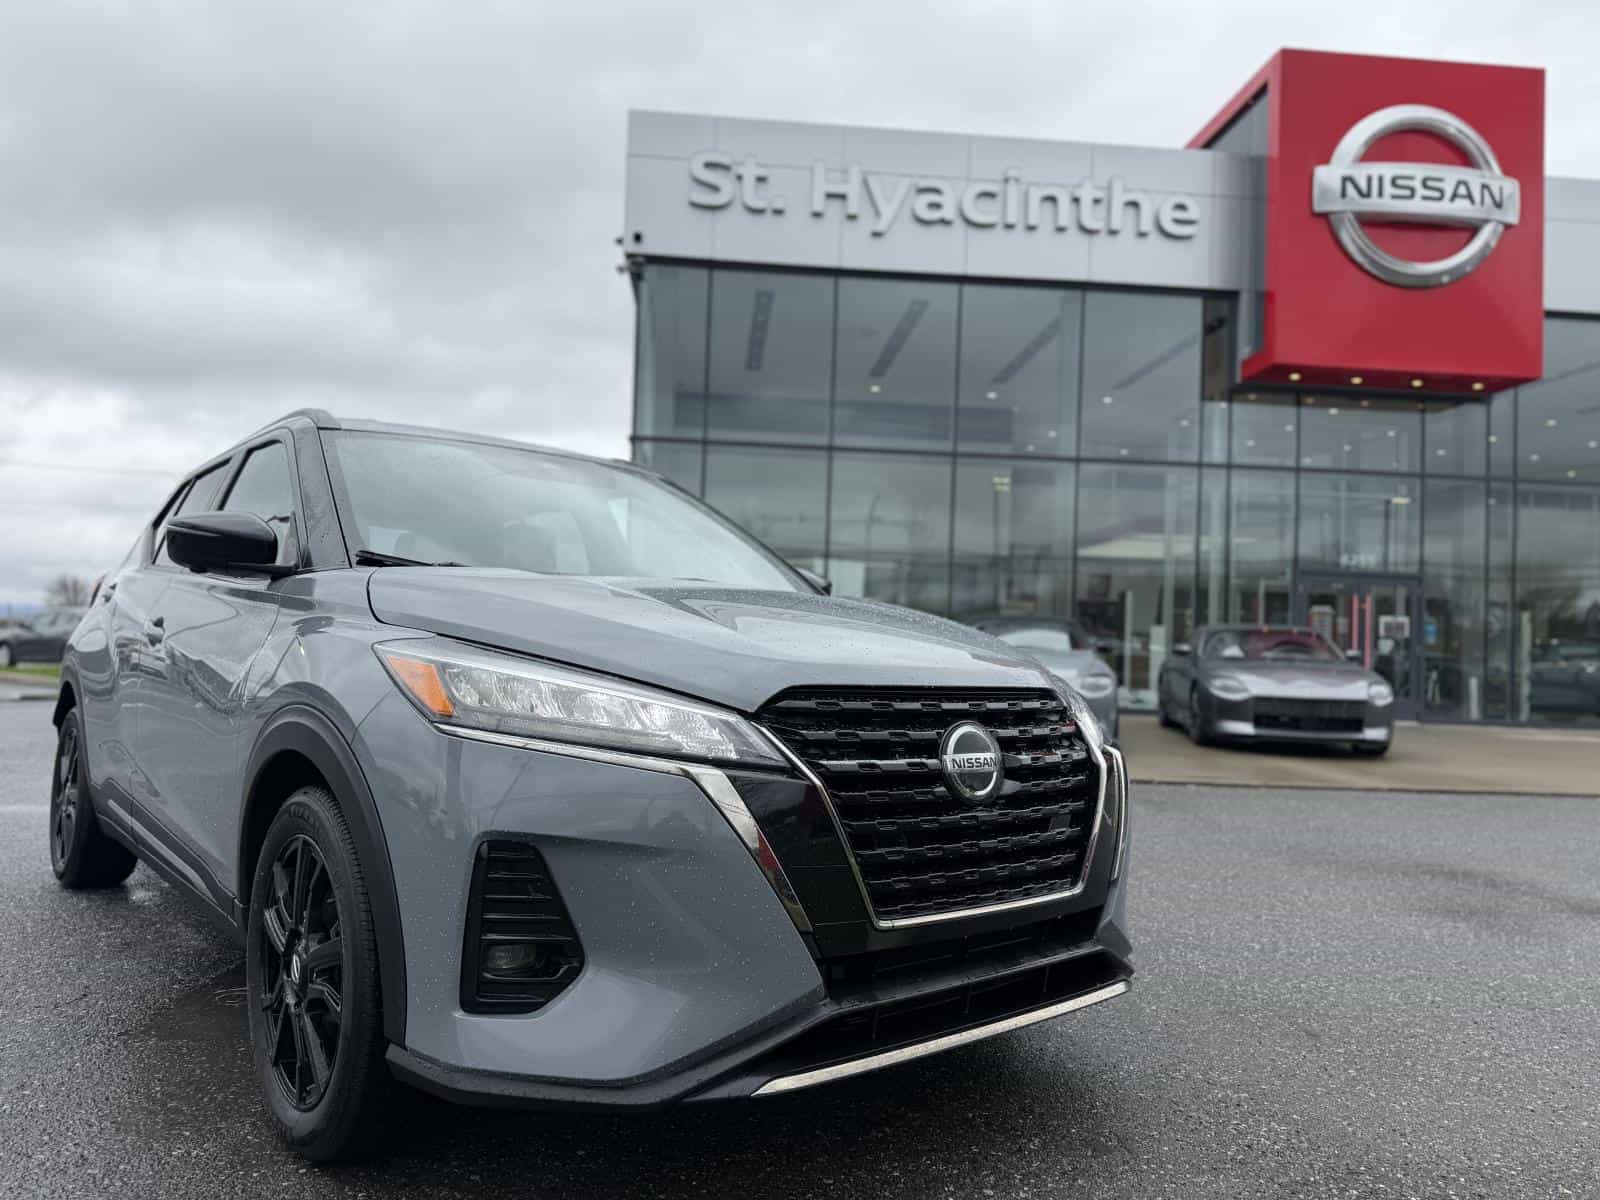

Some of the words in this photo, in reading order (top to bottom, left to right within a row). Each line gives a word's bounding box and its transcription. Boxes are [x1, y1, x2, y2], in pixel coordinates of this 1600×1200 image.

[687, 151, 785, 216] St.
[810, 160, 1200, 240] Hyacinthe
[1340, 174, 1504, 210] NISSAN
[951, 756, 998, 769] NISSAN
